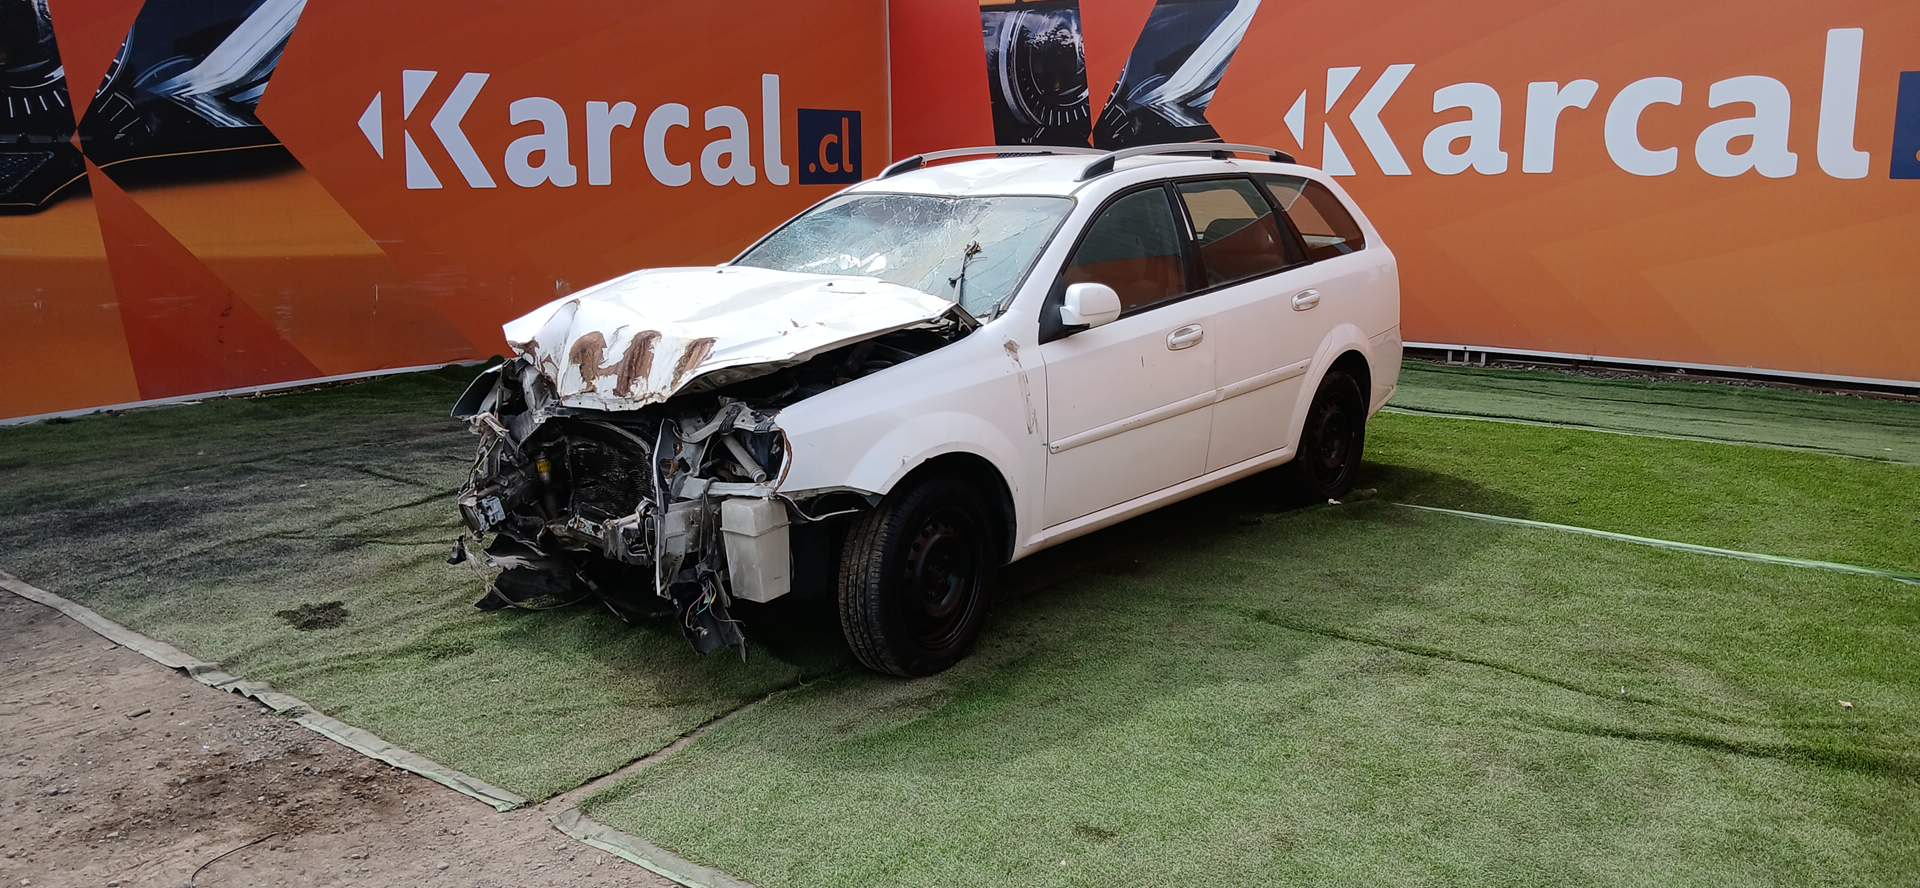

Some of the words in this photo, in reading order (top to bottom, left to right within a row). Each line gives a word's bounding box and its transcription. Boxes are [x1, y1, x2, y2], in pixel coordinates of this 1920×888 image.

[402, 69, 790, 190] Karcal
[808, 116, 854, 173] .cl
[1321, 27, 1870, 180] Karcal
